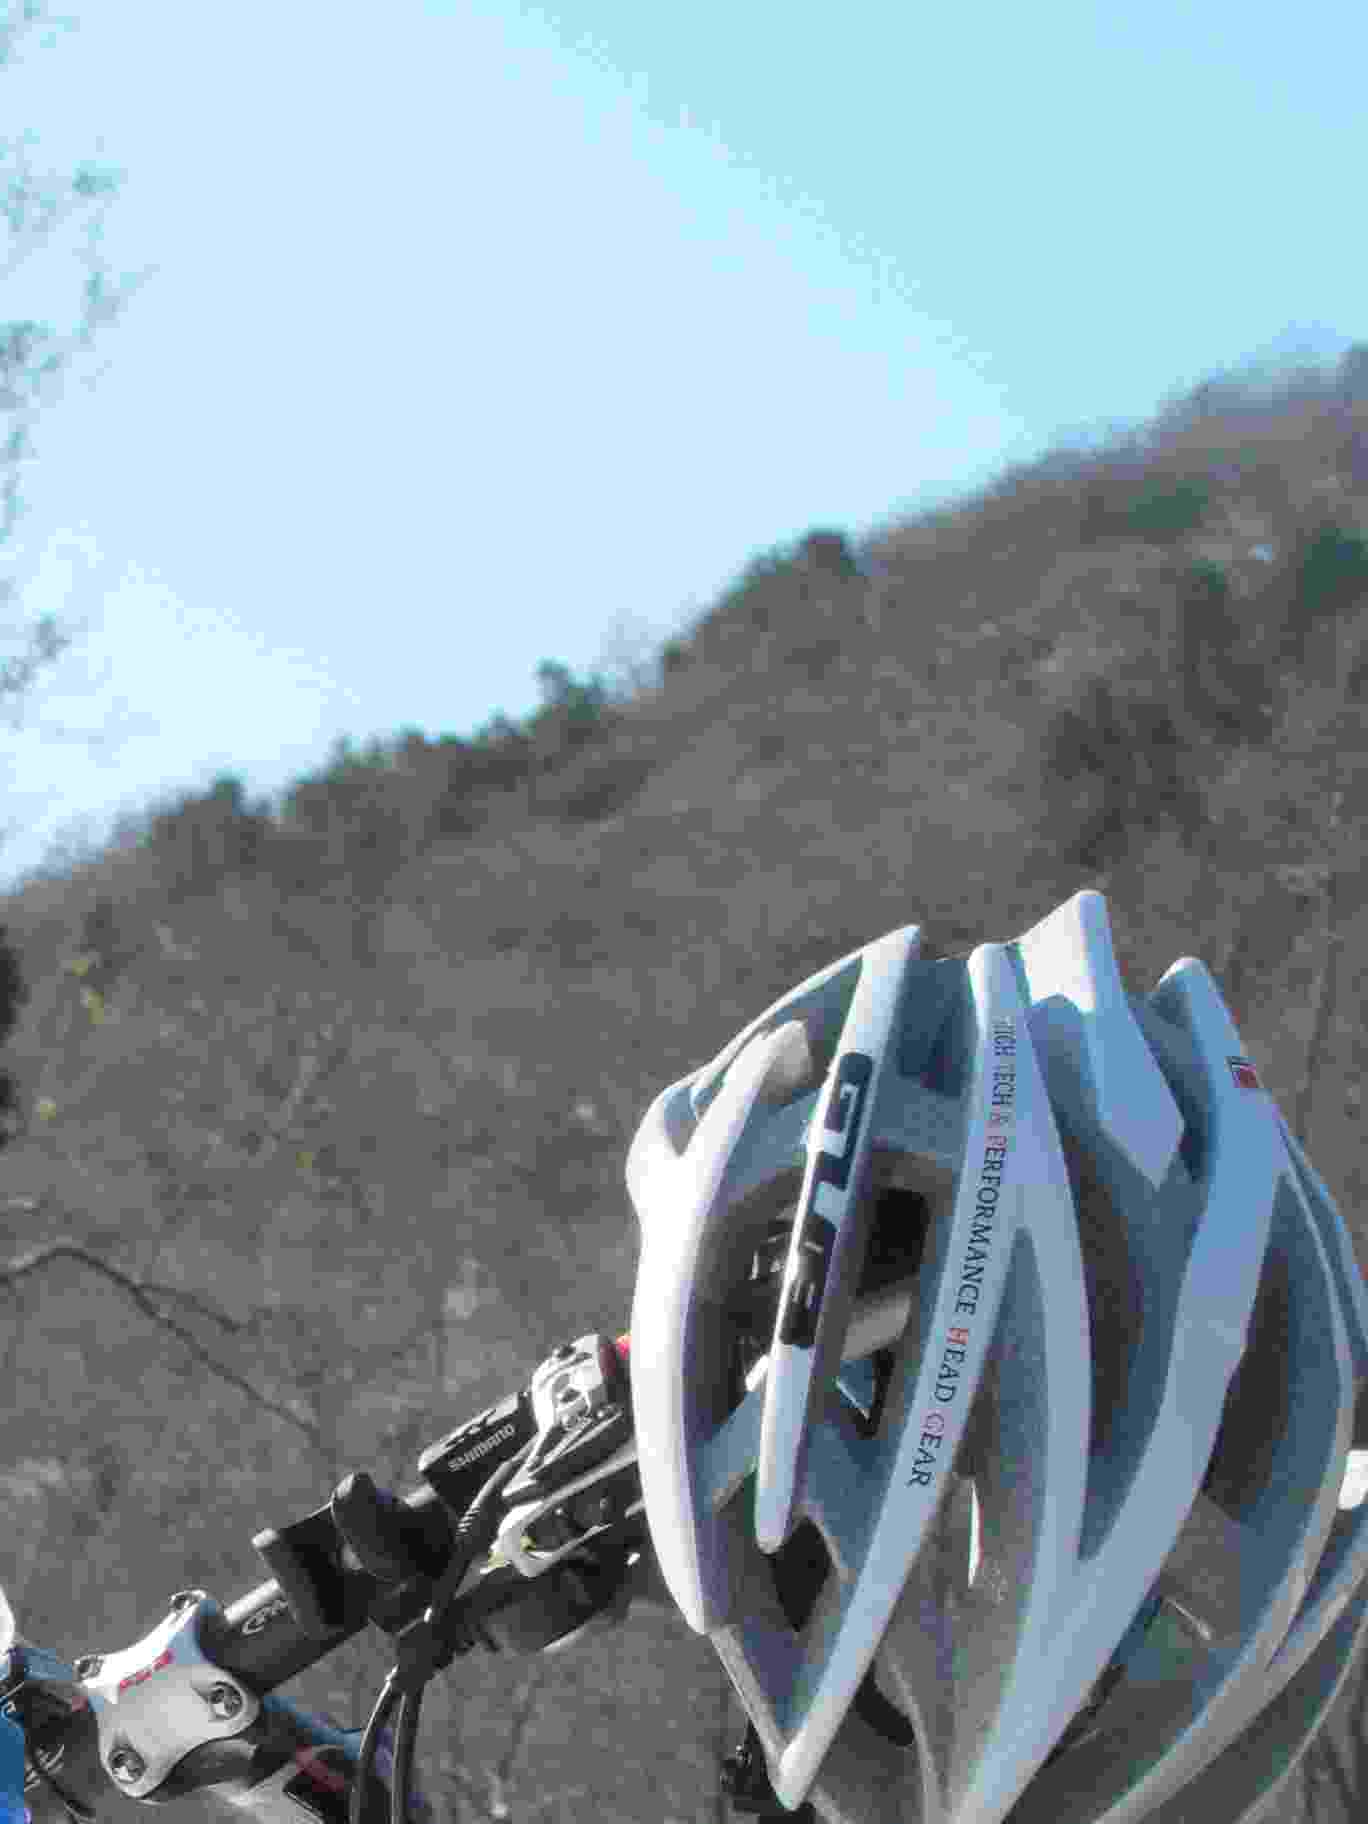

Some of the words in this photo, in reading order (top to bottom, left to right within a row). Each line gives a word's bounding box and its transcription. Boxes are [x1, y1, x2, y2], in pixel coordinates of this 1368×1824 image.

[955, 1135, 1009, 1317] PERFORMANCE
[933, 1327, 969, 1403] HEAD
[905, 1411, 947, 1489] GEAR
